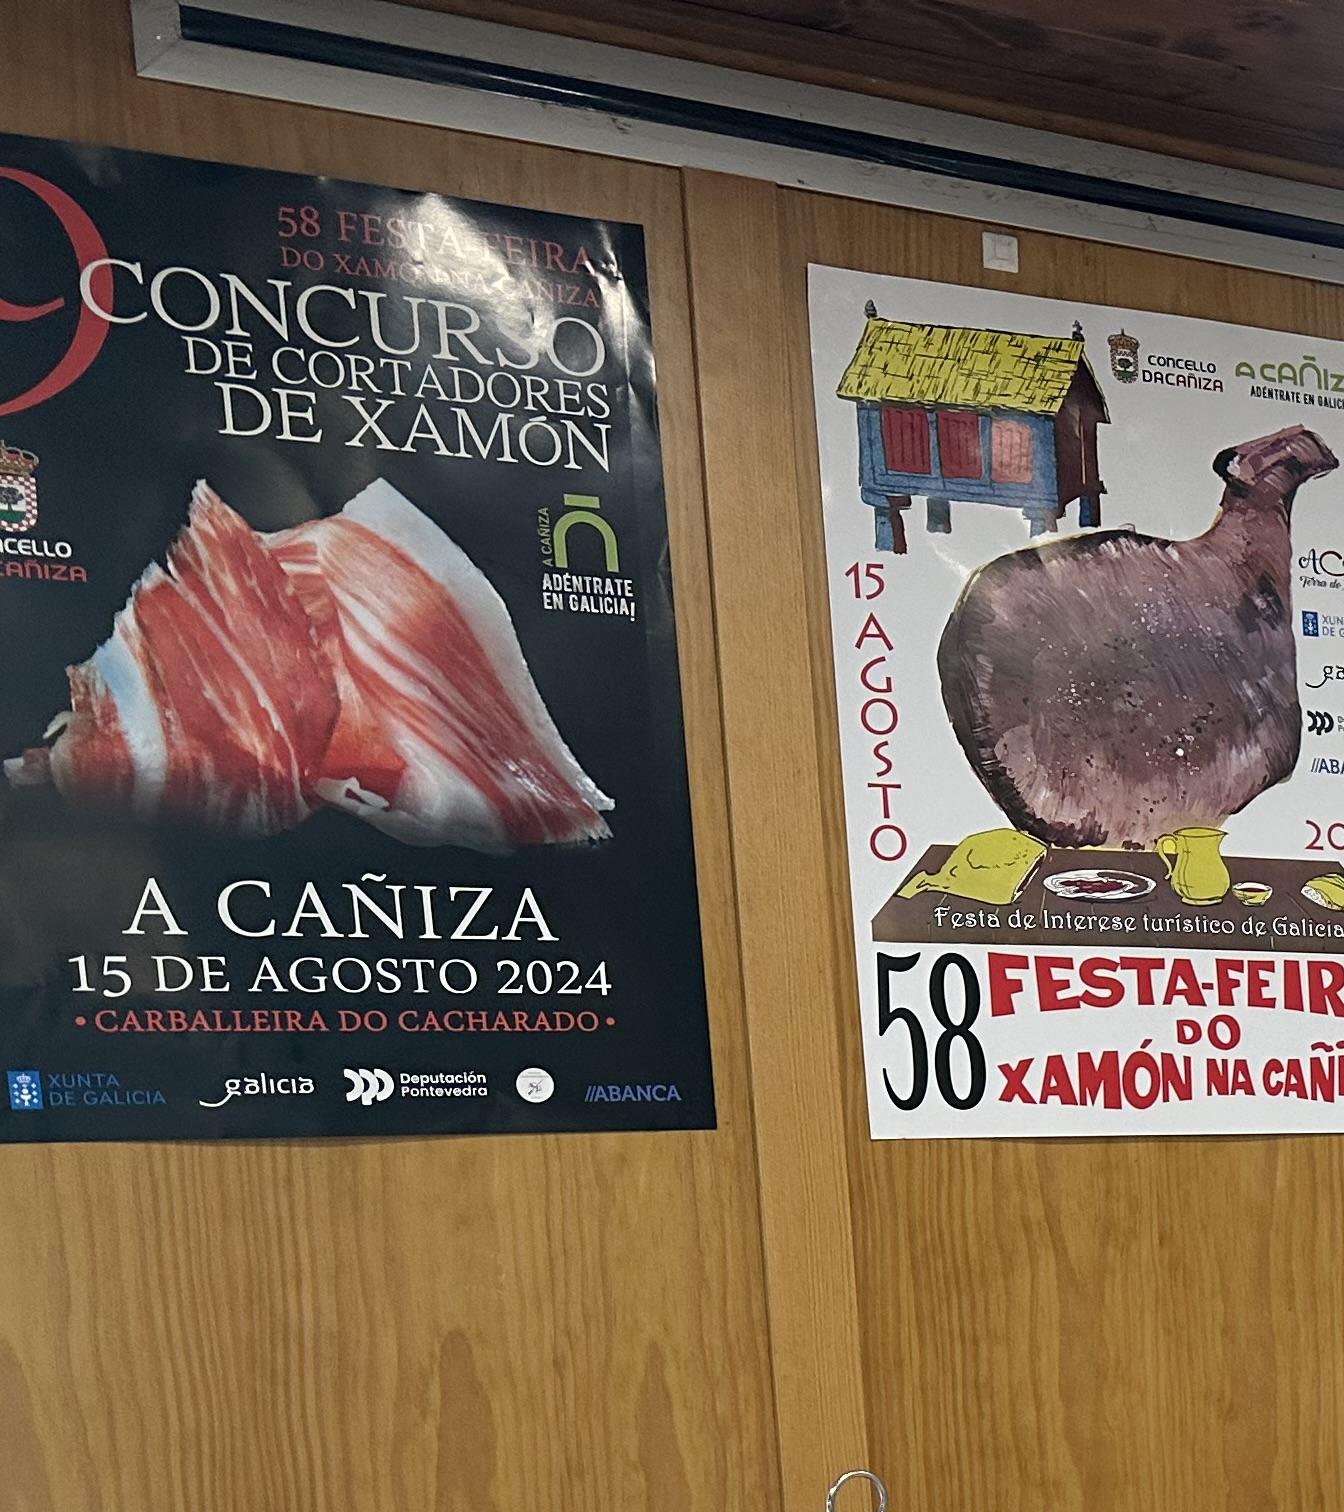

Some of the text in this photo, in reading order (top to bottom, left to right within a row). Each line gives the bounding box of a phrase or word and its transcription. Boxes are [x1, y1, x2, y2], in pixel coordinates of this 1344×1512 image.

[277, 205, 321, 239] 58
[81, 259, 606, 378] CONCURSO
[184, 337, 610, 420] DE CORTADORES
[1147, 355, 1217, 374] CONCELLO
[214, 381, 610, 473] DE XAMÓN
[542, 572, 634, 597] ADÉNTRATE
[844, 562, 884, 600] 15
[542, 592, 635, 622] EN GALICIA!
[122, 873, 558, 942] A CAÑIZA
[934, 906, 1344, 938] Festa de Interese turístico de Galicia
[70, 953, 613, 997] 15 DE AGOSTO 2024
[95, 1009, 599, 1034] CARBALLEIRA DO CACHARADO
[876, 951, 988, 1111] 58
[1176, 1013, 1241, 1051] DO
[200, 1072, 314, 1107] galicia
[400, 1071, 487, 1086] Deputación
[401, 1084, 488, 1098] Pontevedra
[997, 1039, 1193, 1109] XAMÓN
[1206, 1056, 1254, 1097] NA
